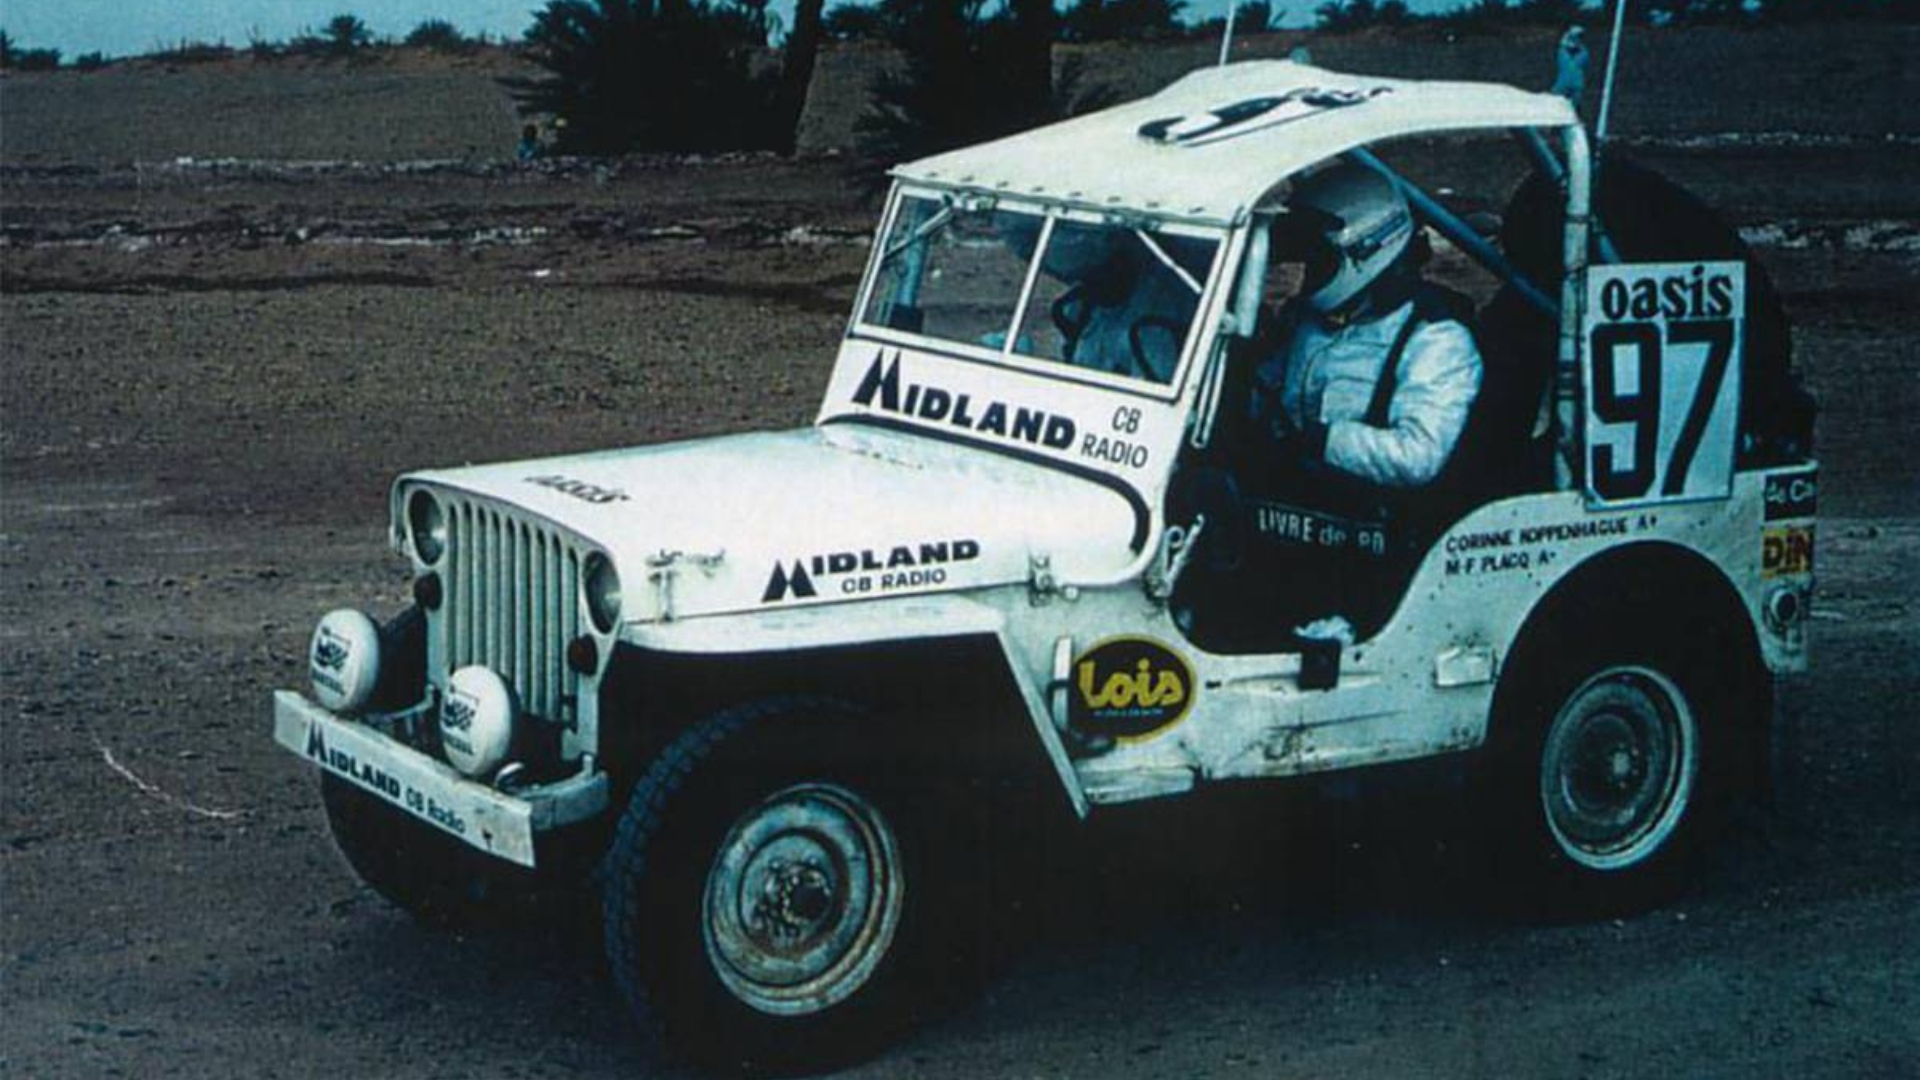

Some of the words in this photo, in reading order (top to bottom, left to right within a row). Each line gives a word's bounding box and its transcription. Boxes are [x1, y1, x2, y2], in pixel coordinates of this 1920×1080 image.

[1601, 265, 1733, 320] oasis
[851, 347, 1077, 450] MIDLAND
[1112, 406, 1142, 434] CB
[1590, 318, 1736, 500] 97
[1081, 433, 1149, 469] RADIO
[1258, 508, 1315, 542] LIVRE
[1318, 524, 1346, 546] de
[1446, 529, 1512, 553] CORINNE
[761, 539, 981, 603] MIDLAND
[841, 577, 871, 594] CB
[880, 568, 947, 588] RADIO
[306, 720, 401, 799] MIDLAND
[406, 786, 424, 812] CB
